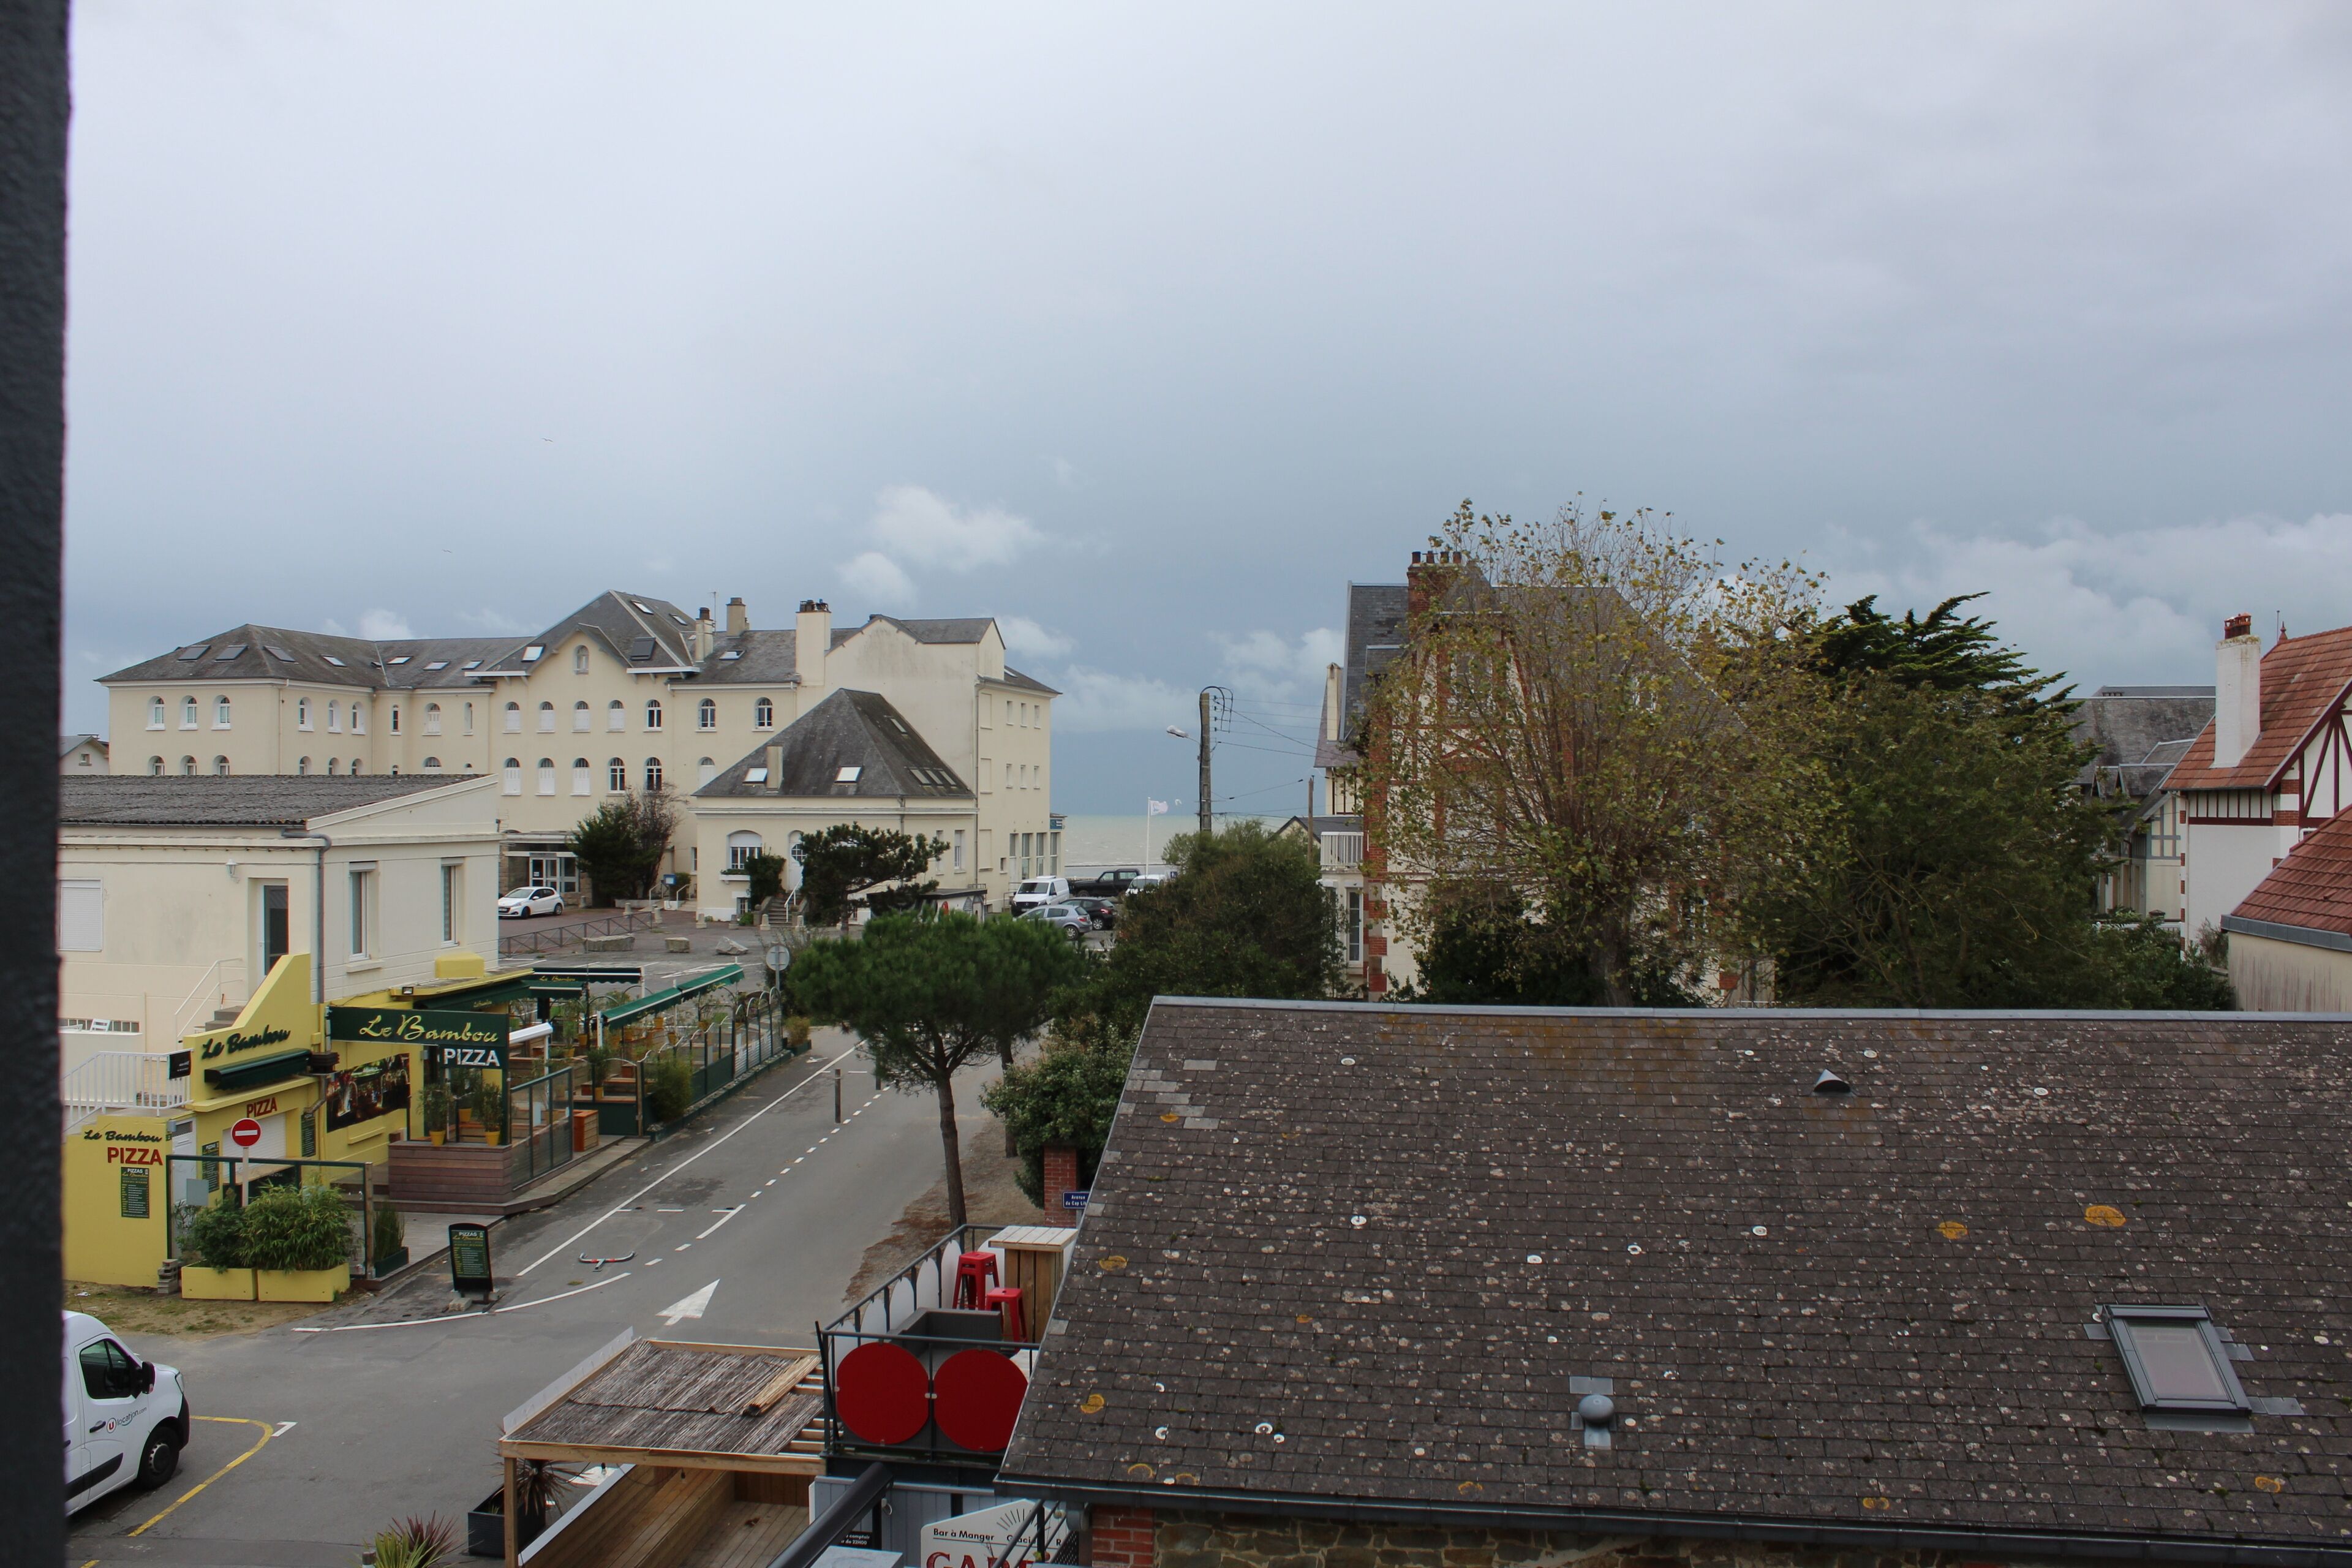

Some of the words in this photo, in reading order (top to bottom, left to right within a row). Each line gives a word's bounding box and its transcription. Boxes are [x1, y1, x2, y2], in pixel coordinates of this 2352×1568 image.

[359, 1015, 392, 1037] Le
[396, 1014, 498, 1042] Bambou
[202, 1038, 225, 1059] Le
[227, 1024, 291, 1054] Bambou
[444, 1048, 500, 1066] PIZZA
[246, 1097, 277, 1118] PIZZA
[84, 1129, 102, 1140] Le
[105, 1131, 162, 1142] Bambou
[107, 1147, 163, 1166] PIZZA
[117, 1406, 148, 1426] location.com
[933, 1528, 949, 1537] Bar
[959, 1530, 995, 1544] Manger
